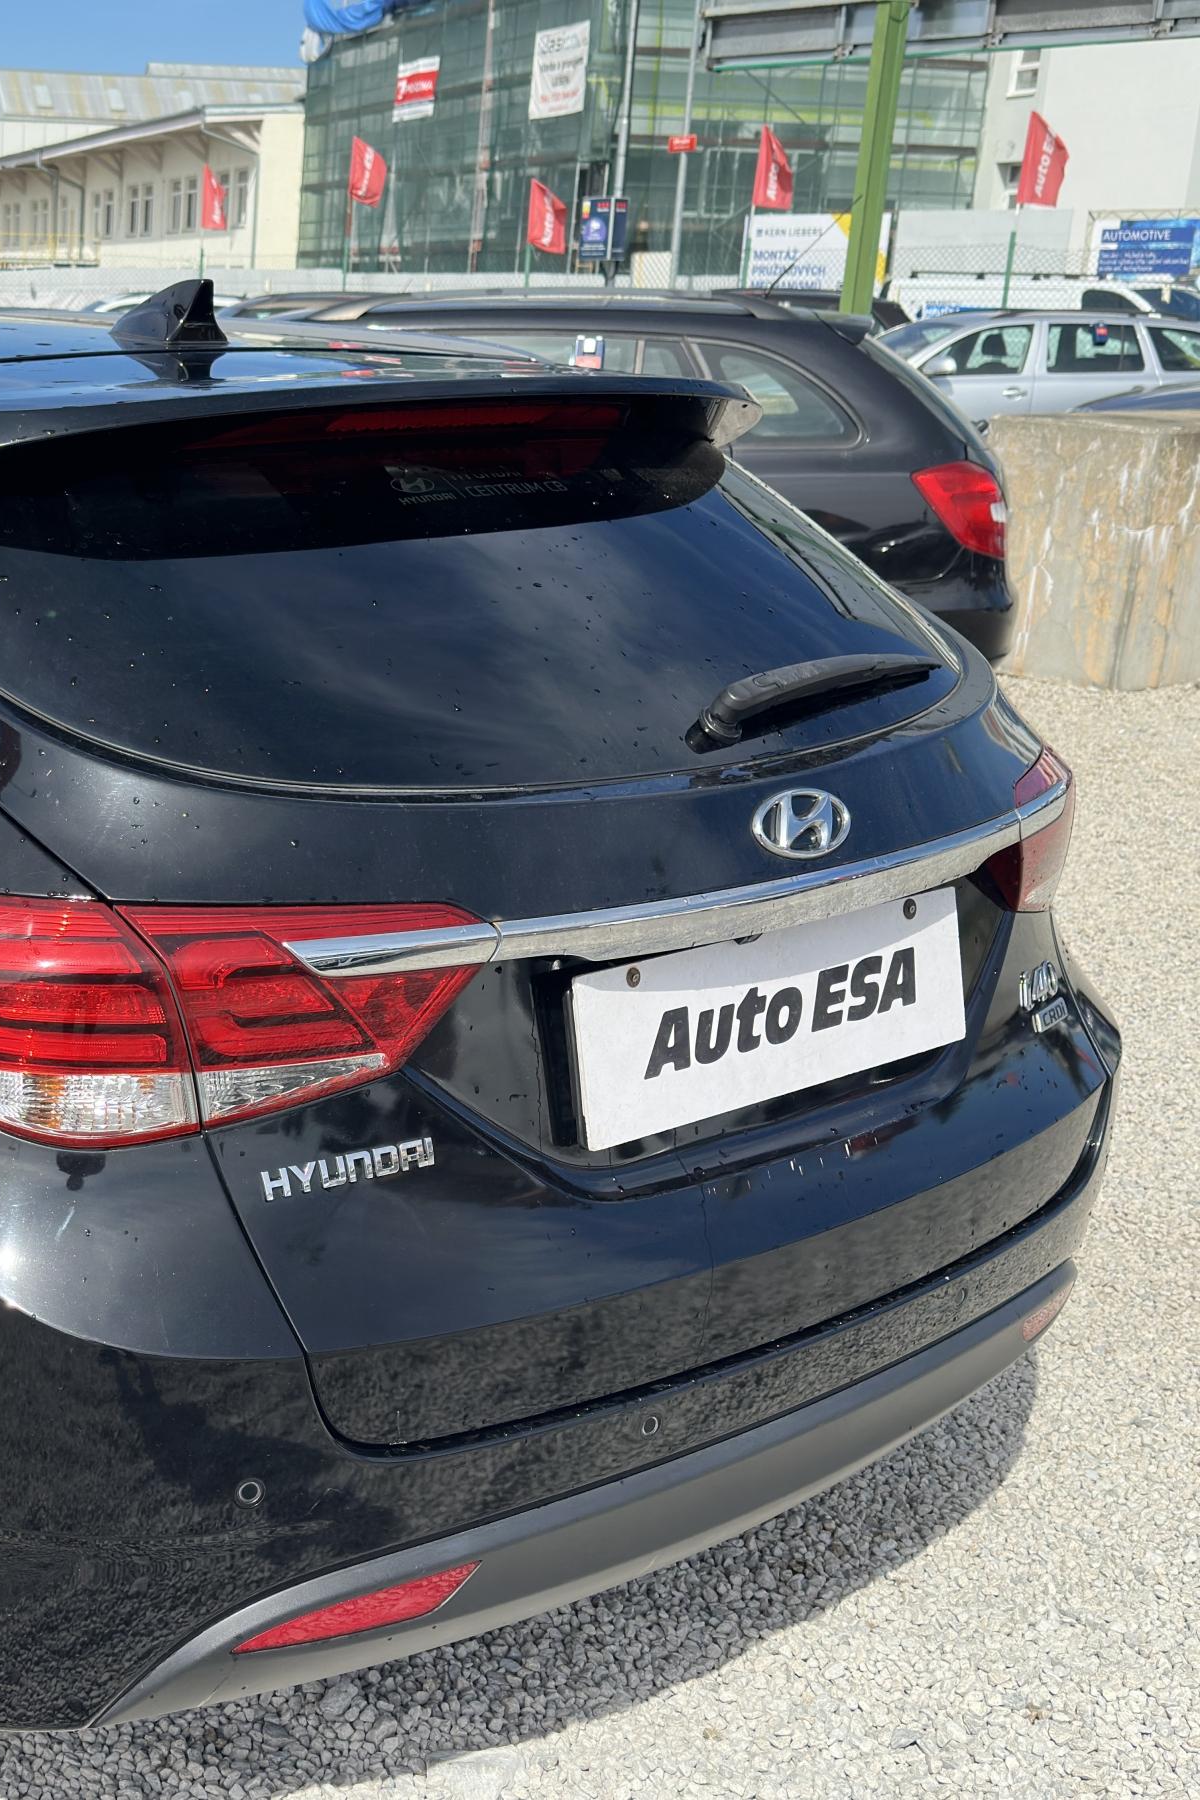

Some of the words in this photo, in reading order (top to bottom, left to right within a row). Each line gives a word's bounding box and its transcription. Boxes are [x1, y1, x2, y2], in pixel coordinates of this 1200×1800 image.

[1034, 154, 1052, 198] Auto
[1103, 229, 1172, 240] AUTOMOTIVE
[753, 246, 799, 260] MONTÁŽ
[465, 481, 546, 498] CENTRUM
[644, 987, 803, 1080] Auto
[811, 947, 917, 1033] ESA
[260, 1137, 435, 1201] HYUNDAI
